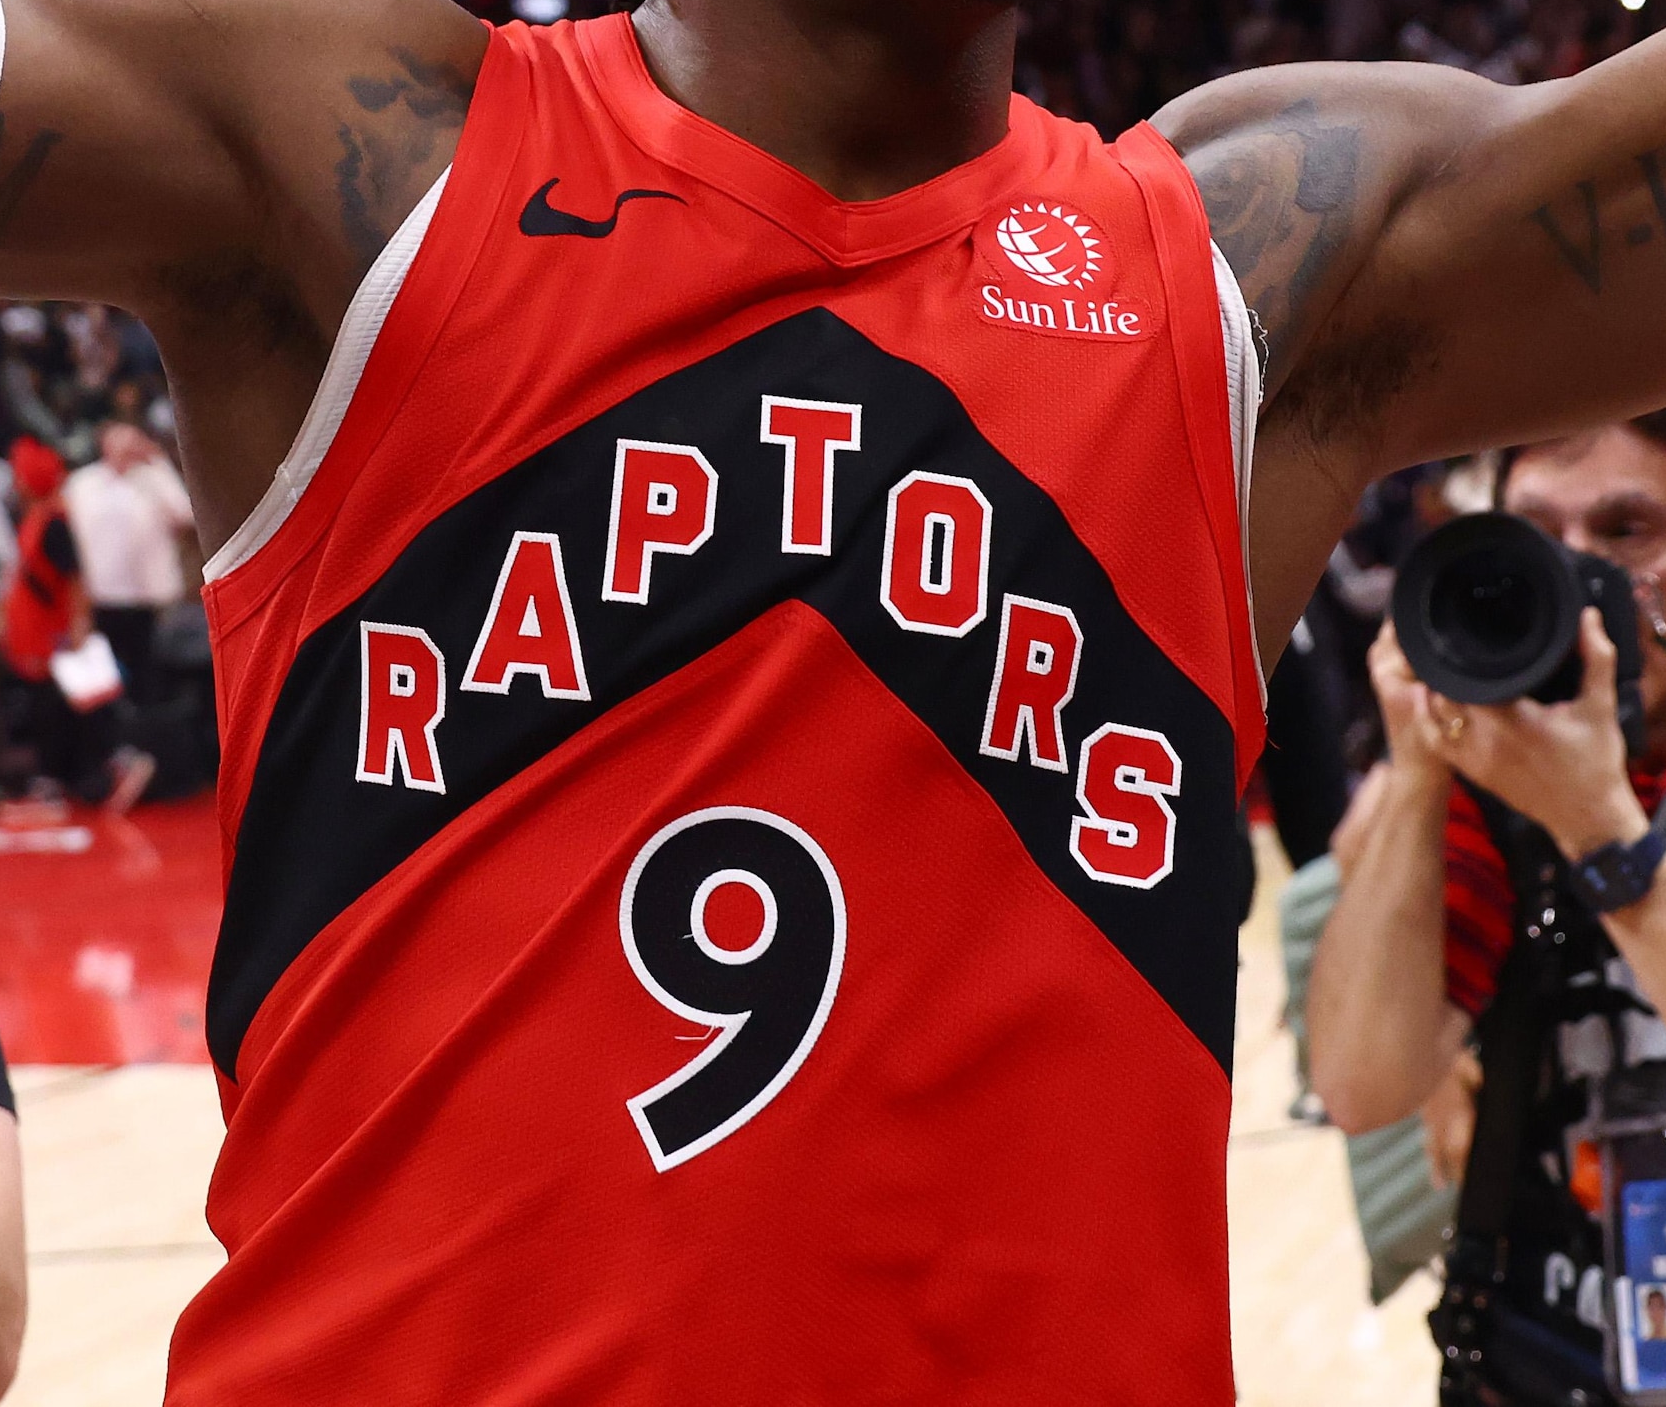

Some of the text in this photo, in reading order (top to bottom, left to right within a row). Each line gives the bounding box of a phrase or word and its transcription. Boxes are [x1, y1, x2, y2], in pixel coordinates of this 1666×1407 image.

[981, 284, 1142, 336] Sun Life
[356, 394, 1182, 890] RAPTORS
[619, 805, 847, 1173] 9
